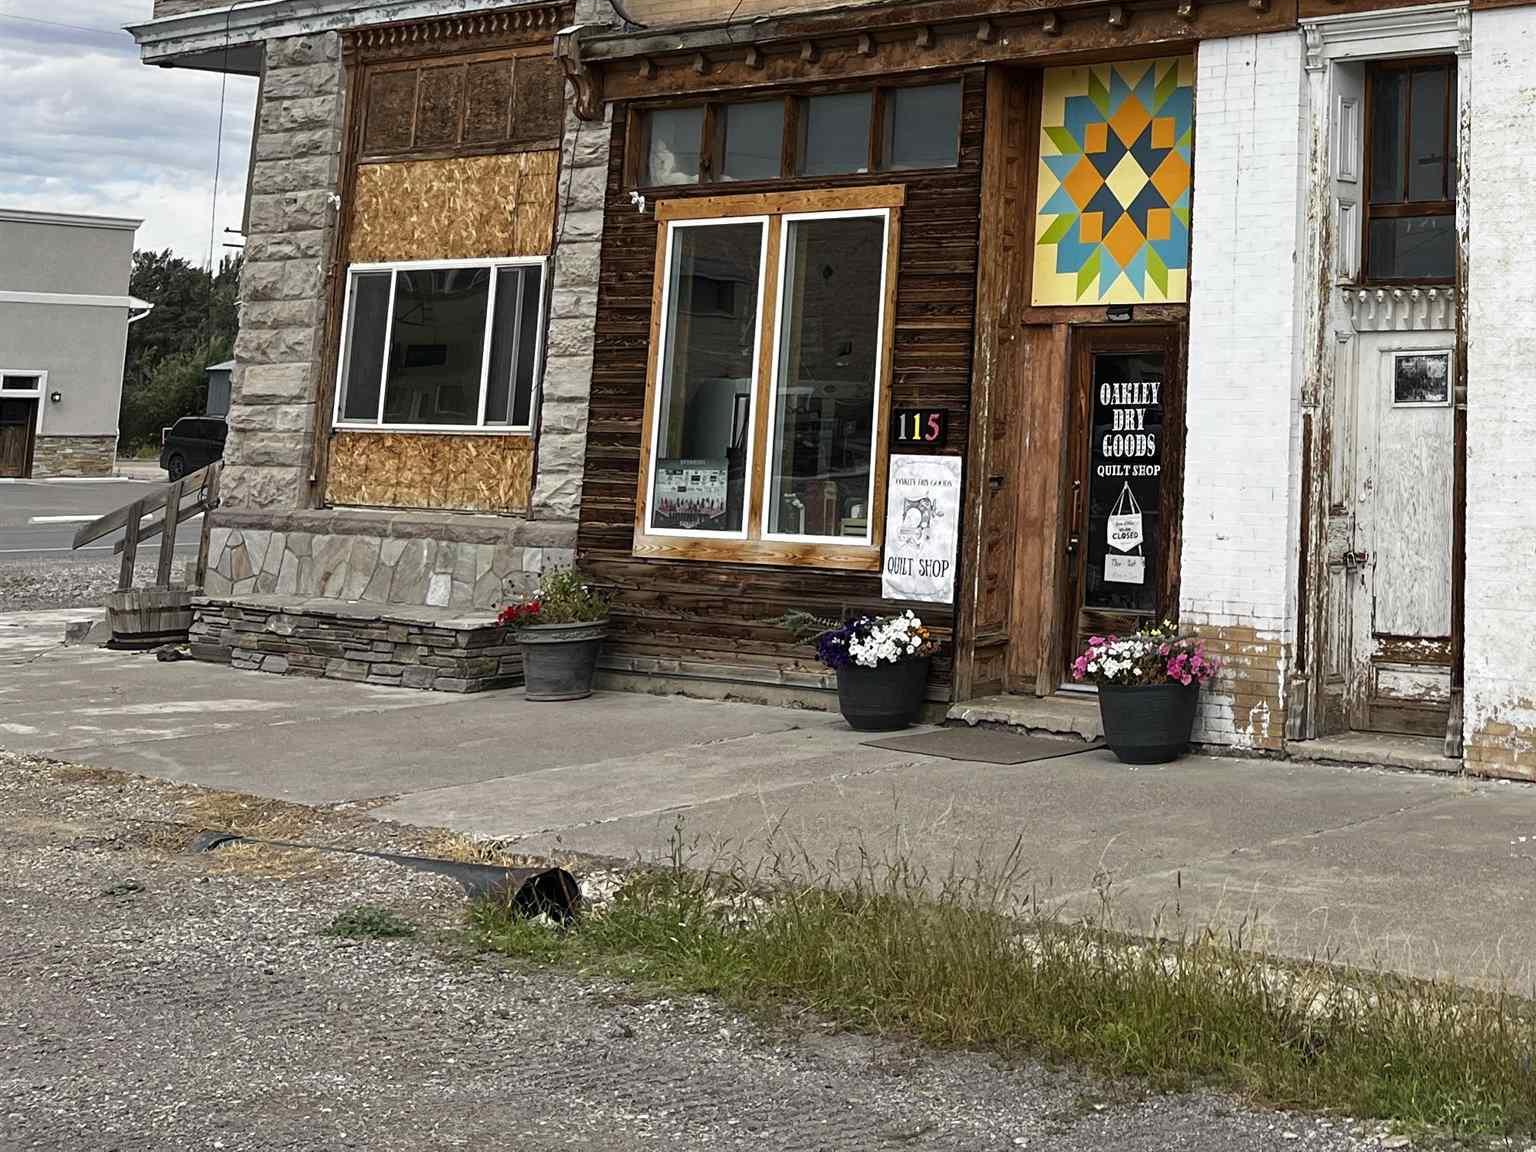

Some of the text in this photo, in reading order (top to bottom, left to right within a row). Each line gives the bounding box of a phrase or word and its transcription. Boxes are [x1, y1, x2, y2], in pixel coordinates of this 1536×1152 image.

[1100, 382, 1160, 405] OAKLEY
[898, 413, 940, 441] 115
[1112, 408, 1146, 431] DRY
[1102, 434, 1155, 457] GOODS
[1097, 464, 1160, 477] QUILT SHOP
[1112, 531, 1139, 540] CLOSED
[887, 556, 950, 578] QUILT SHOP
